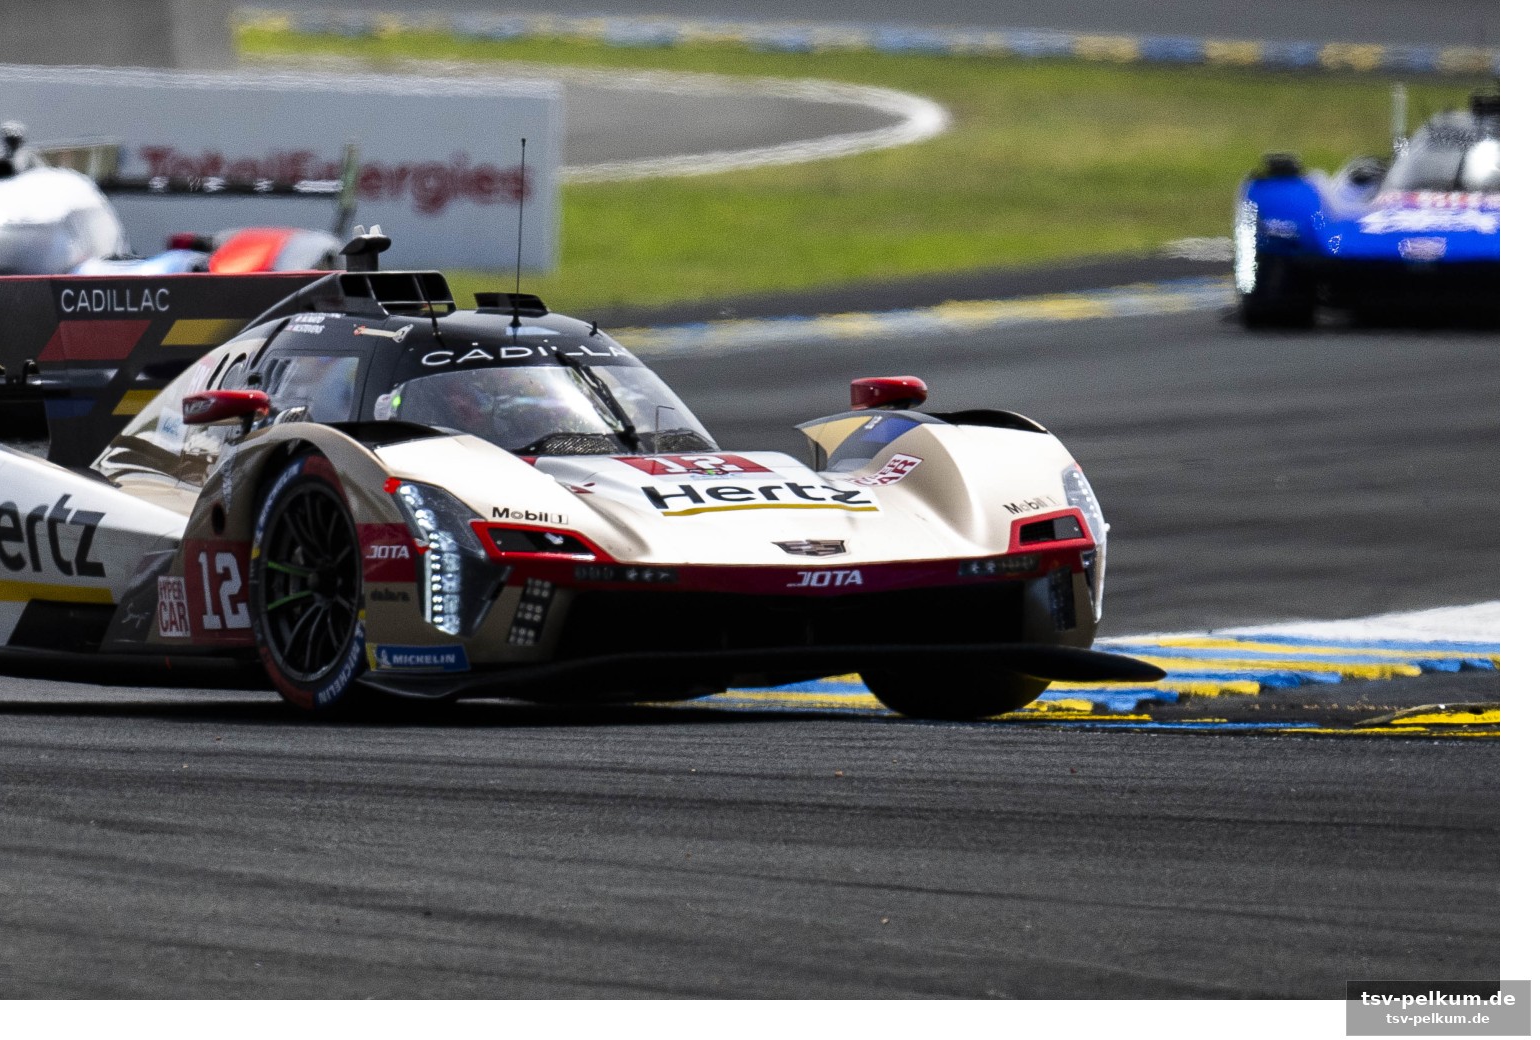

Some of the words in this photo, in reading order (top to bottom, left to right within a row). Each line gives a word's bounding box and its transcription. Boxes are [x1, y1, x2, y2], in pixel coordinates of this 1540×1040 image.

[60, 288, 170, 313] CADILLAC
[421, 345, 624, 367] CADILLA
[641, 482, 872, 509] Hertz
[492, 506, 549, 522] Mobil
[365, 545, 410, 559] JOTA
[787, 569, 864, 588] JOTA
[160, 579, 184, 601] HYPER
[198, 552, 252, 629] 12
[159, 601, 190, 632] CAR
[392, 654, 455, 665] MICHELIN
